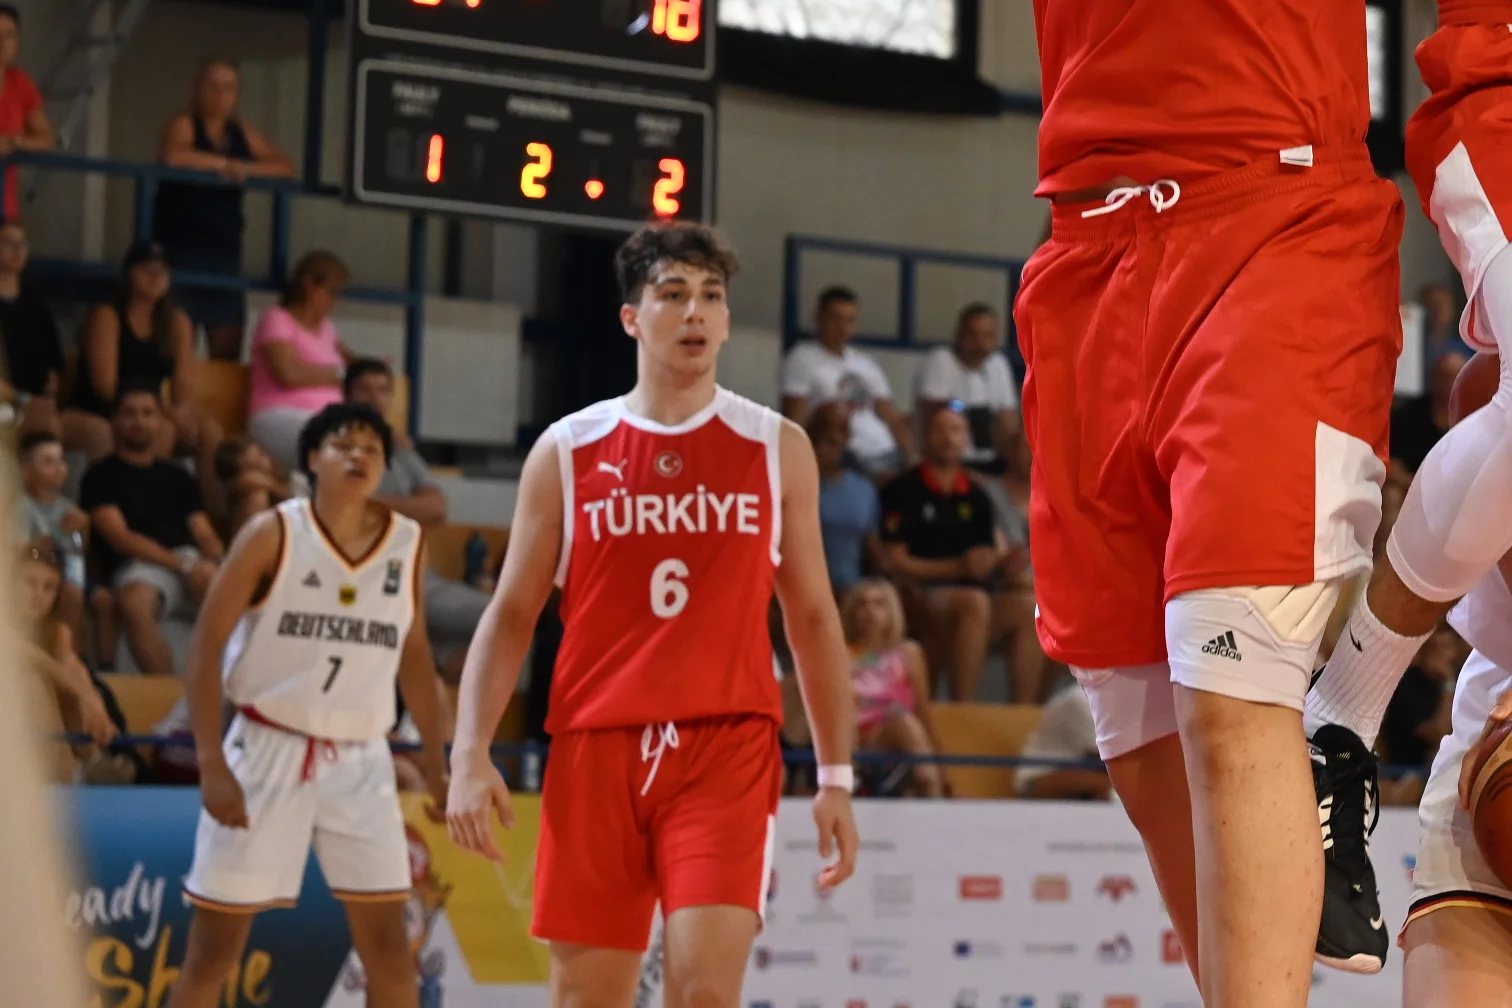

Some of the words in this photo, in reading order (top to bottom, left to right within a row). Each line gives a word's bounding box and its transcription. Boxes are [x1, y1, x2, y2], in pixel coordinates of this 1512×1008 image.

[426, 133, 444, 183] 1
[520, 142, 553, 199] 2
[652, 158, 685, 215] 2
[583, 484, 760, 542] TÜRKİYE
[650, 558, 689, 619] 6
[277, 611, 398, 650] DEUTSCHLAND
[1201, 642, 1242, 662] adidas
[321, 656, 343, 694] 7
